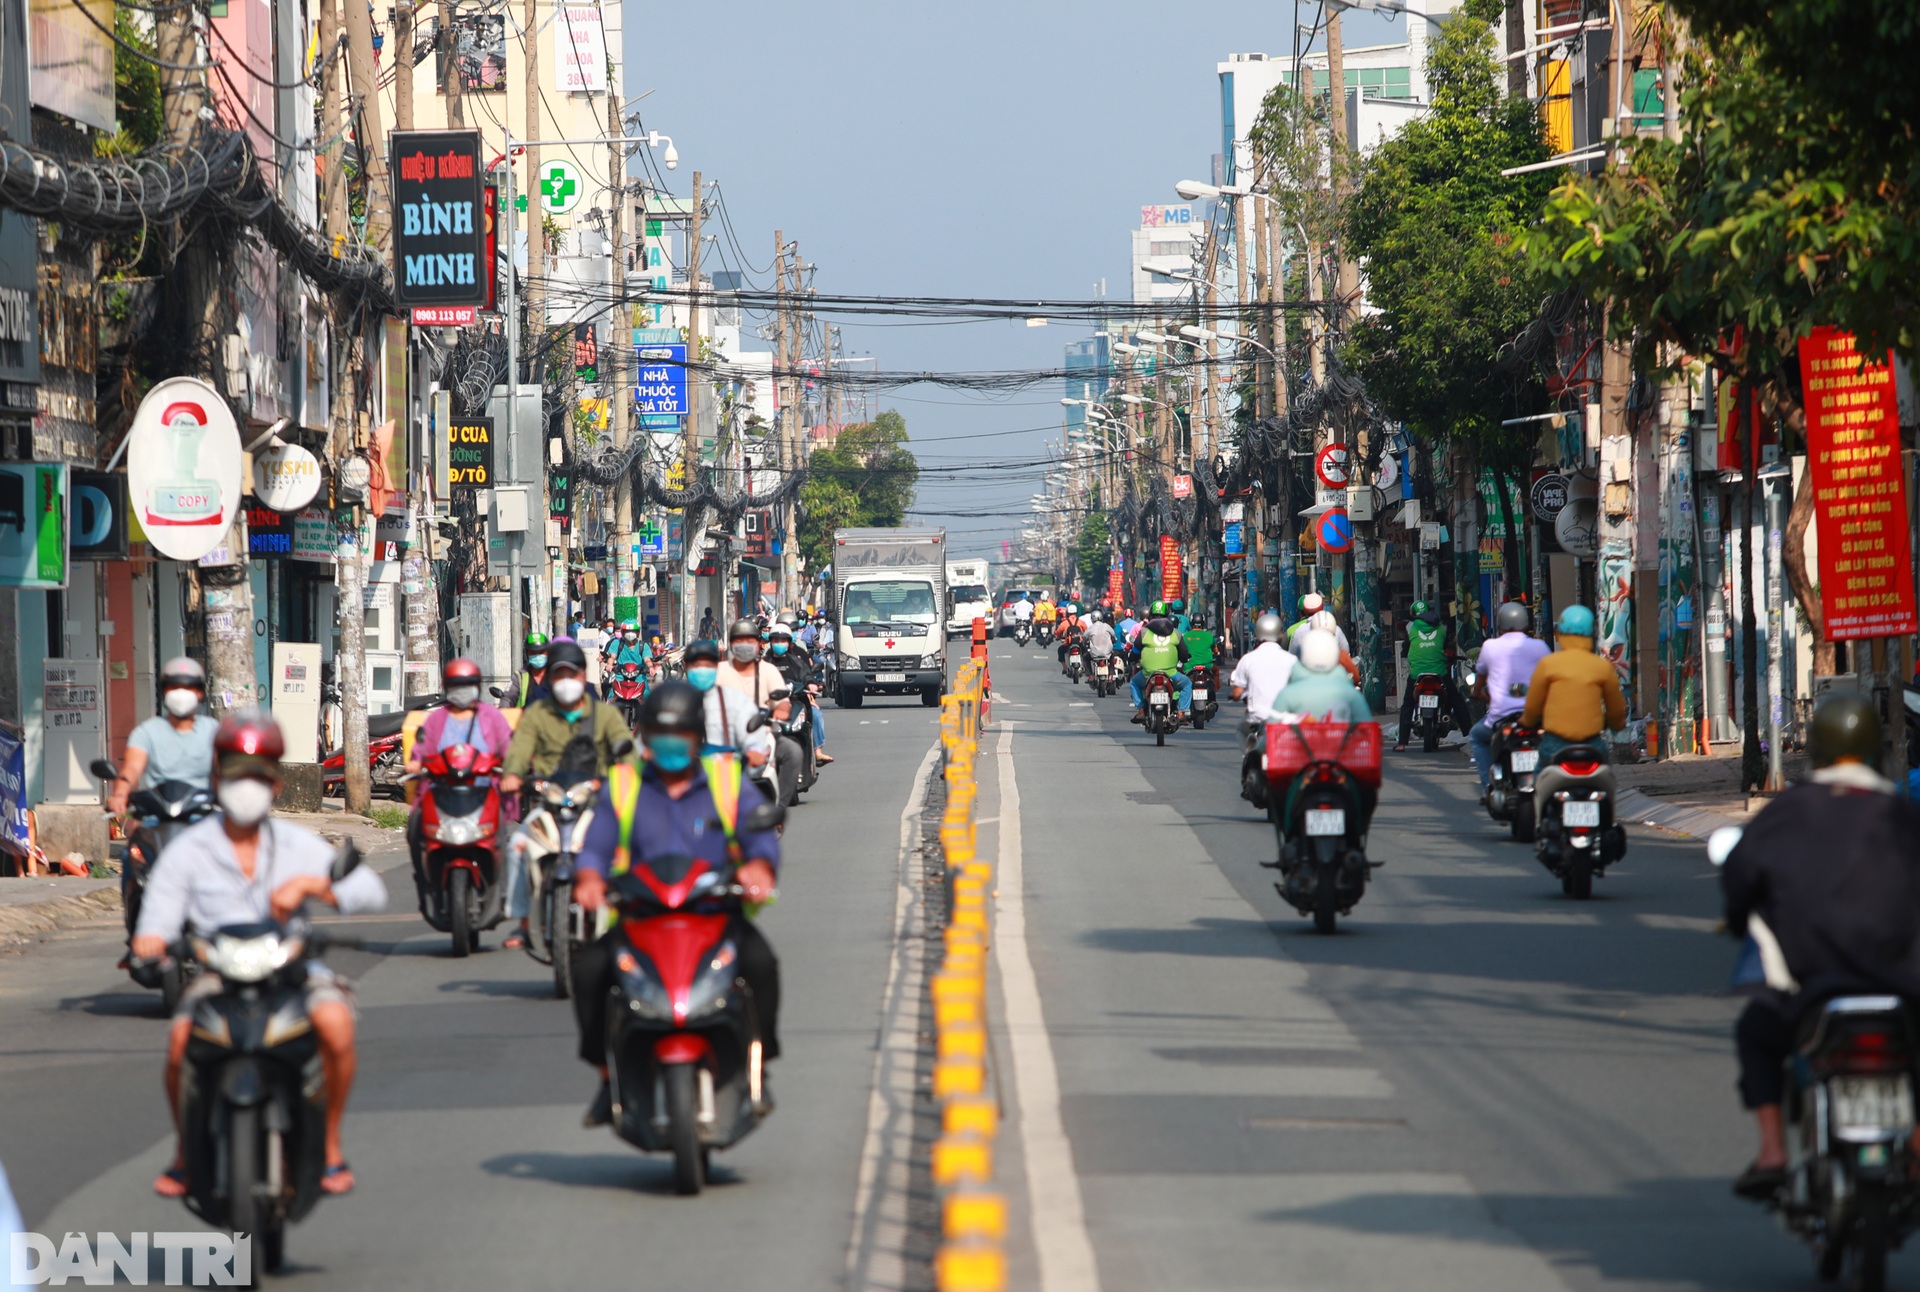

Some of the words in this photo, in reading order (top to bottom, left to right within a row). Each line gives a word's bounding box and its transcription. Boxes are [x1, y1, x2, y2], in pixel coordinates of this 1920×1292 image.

[569, 31, 590, 44] NHA
[566, 53, 594, 66] KHOA
[402, 193, 473, 236] BÌNH
[1164, 208, 1190, 224] MB
[404, 252, 476, 286] MINH
[415, 309, 436, 320] 0903
[438, 309, 454, 320] 113
[456, 309, 472, 322] 057
[643, 368, 669, 382] NHÀ
[636, 399, 656, 412] GIÁ
[657, 396, 678, 412] TỐT
[461, 426, 488, 442] CUA
[261, 461, 313, 482] YUSHI
[1174, 478, 1188, 490] bk
[177, 495, 208, 508] COPY
[1543, 498, 1564, 508] PRO
[249, 533, 290, 552] MINH
